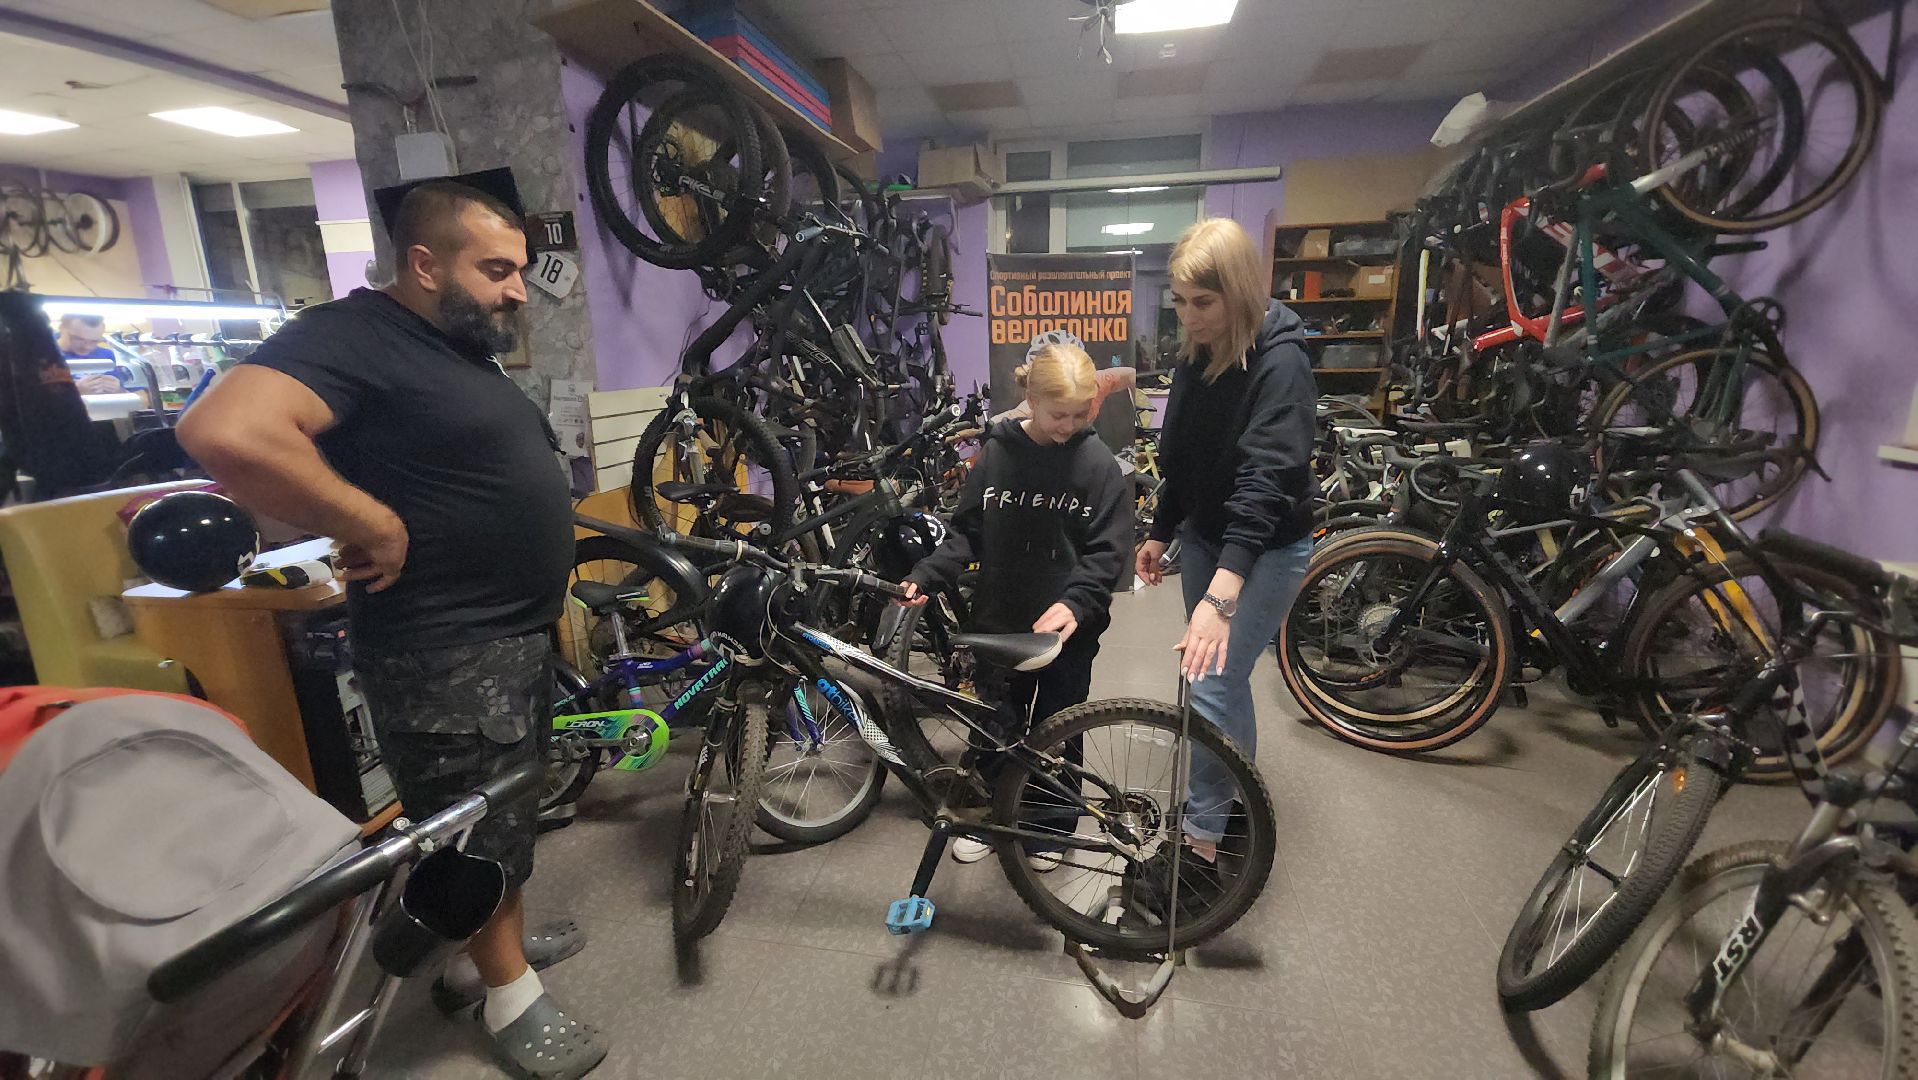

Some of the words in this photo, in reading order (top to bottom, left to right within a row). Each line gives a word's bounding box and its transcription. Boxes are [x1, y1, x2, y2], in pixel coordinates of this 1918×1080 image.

[544, 222, 563, 245] 10
[540, 253, 564, 284] 18
[1106, 270, 1132, 281] проект
[990, 284, 1132, 317] Соболиная
[673, 657, 728, 711] NOVATRA
[1712, 913, 1764, 987] RST
